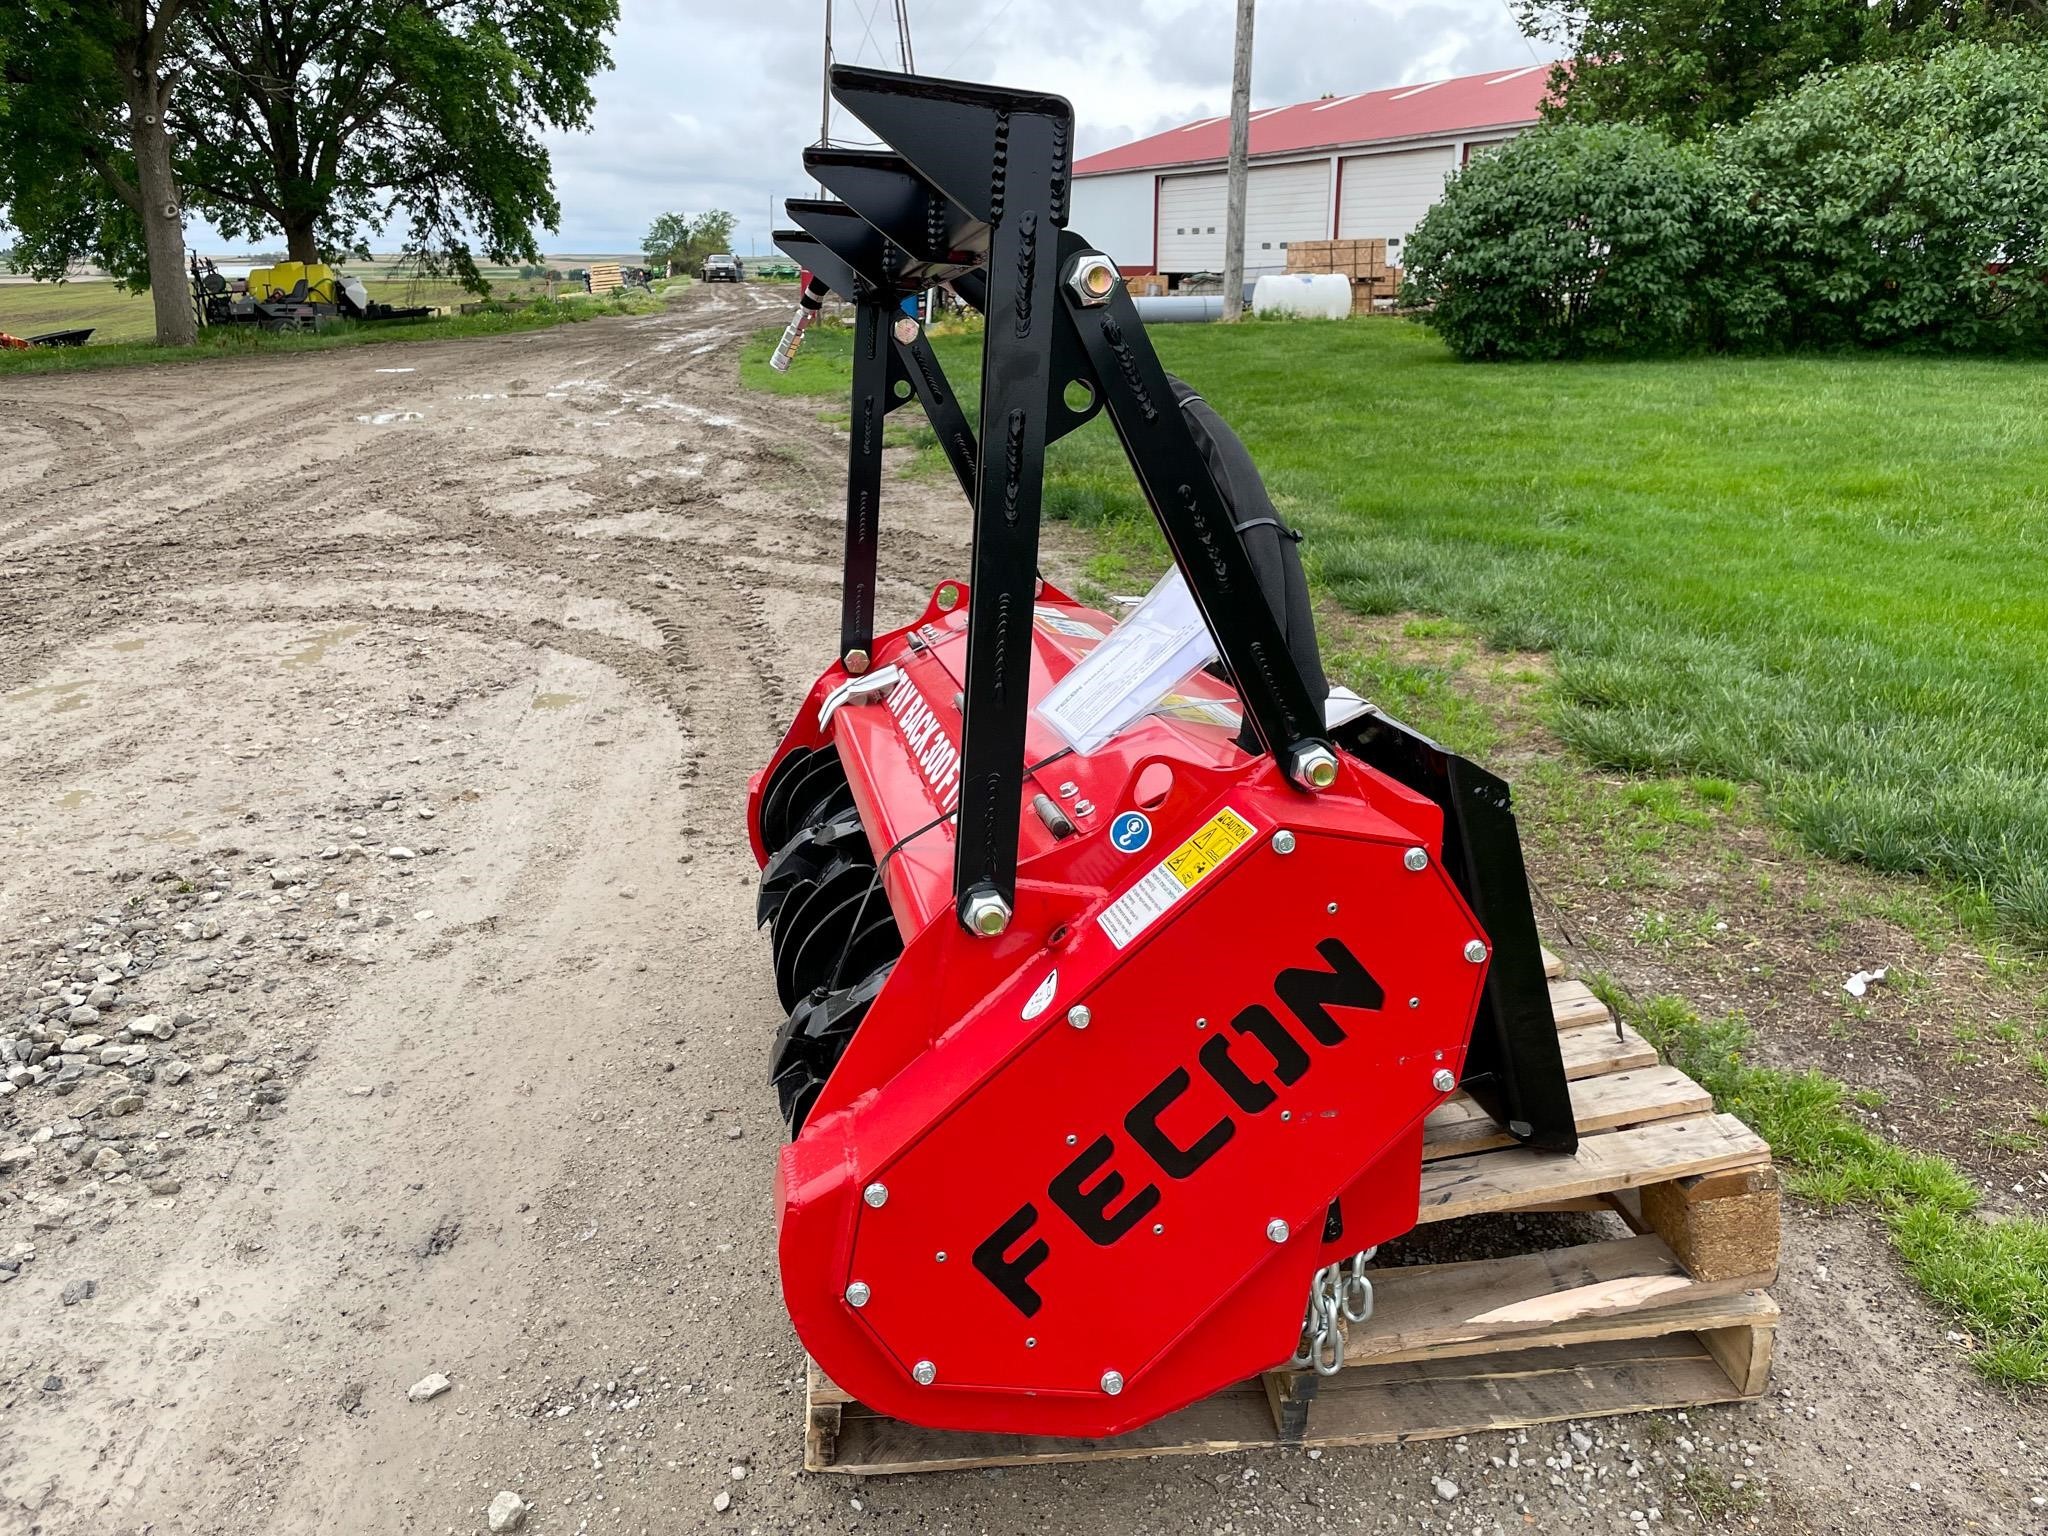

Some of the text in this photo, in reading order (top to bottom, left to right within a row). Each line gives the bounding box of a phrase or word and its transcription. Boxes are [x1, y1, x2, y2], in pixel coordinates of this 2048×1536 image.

[885, 667, 919, 718] TAY
[898, 694, 941, 758] BACK
[919, 731, 956, 784] 300
[1221, 816, 1249, 840] CAUTION
[971, 937, 1385, 1319] FECON
